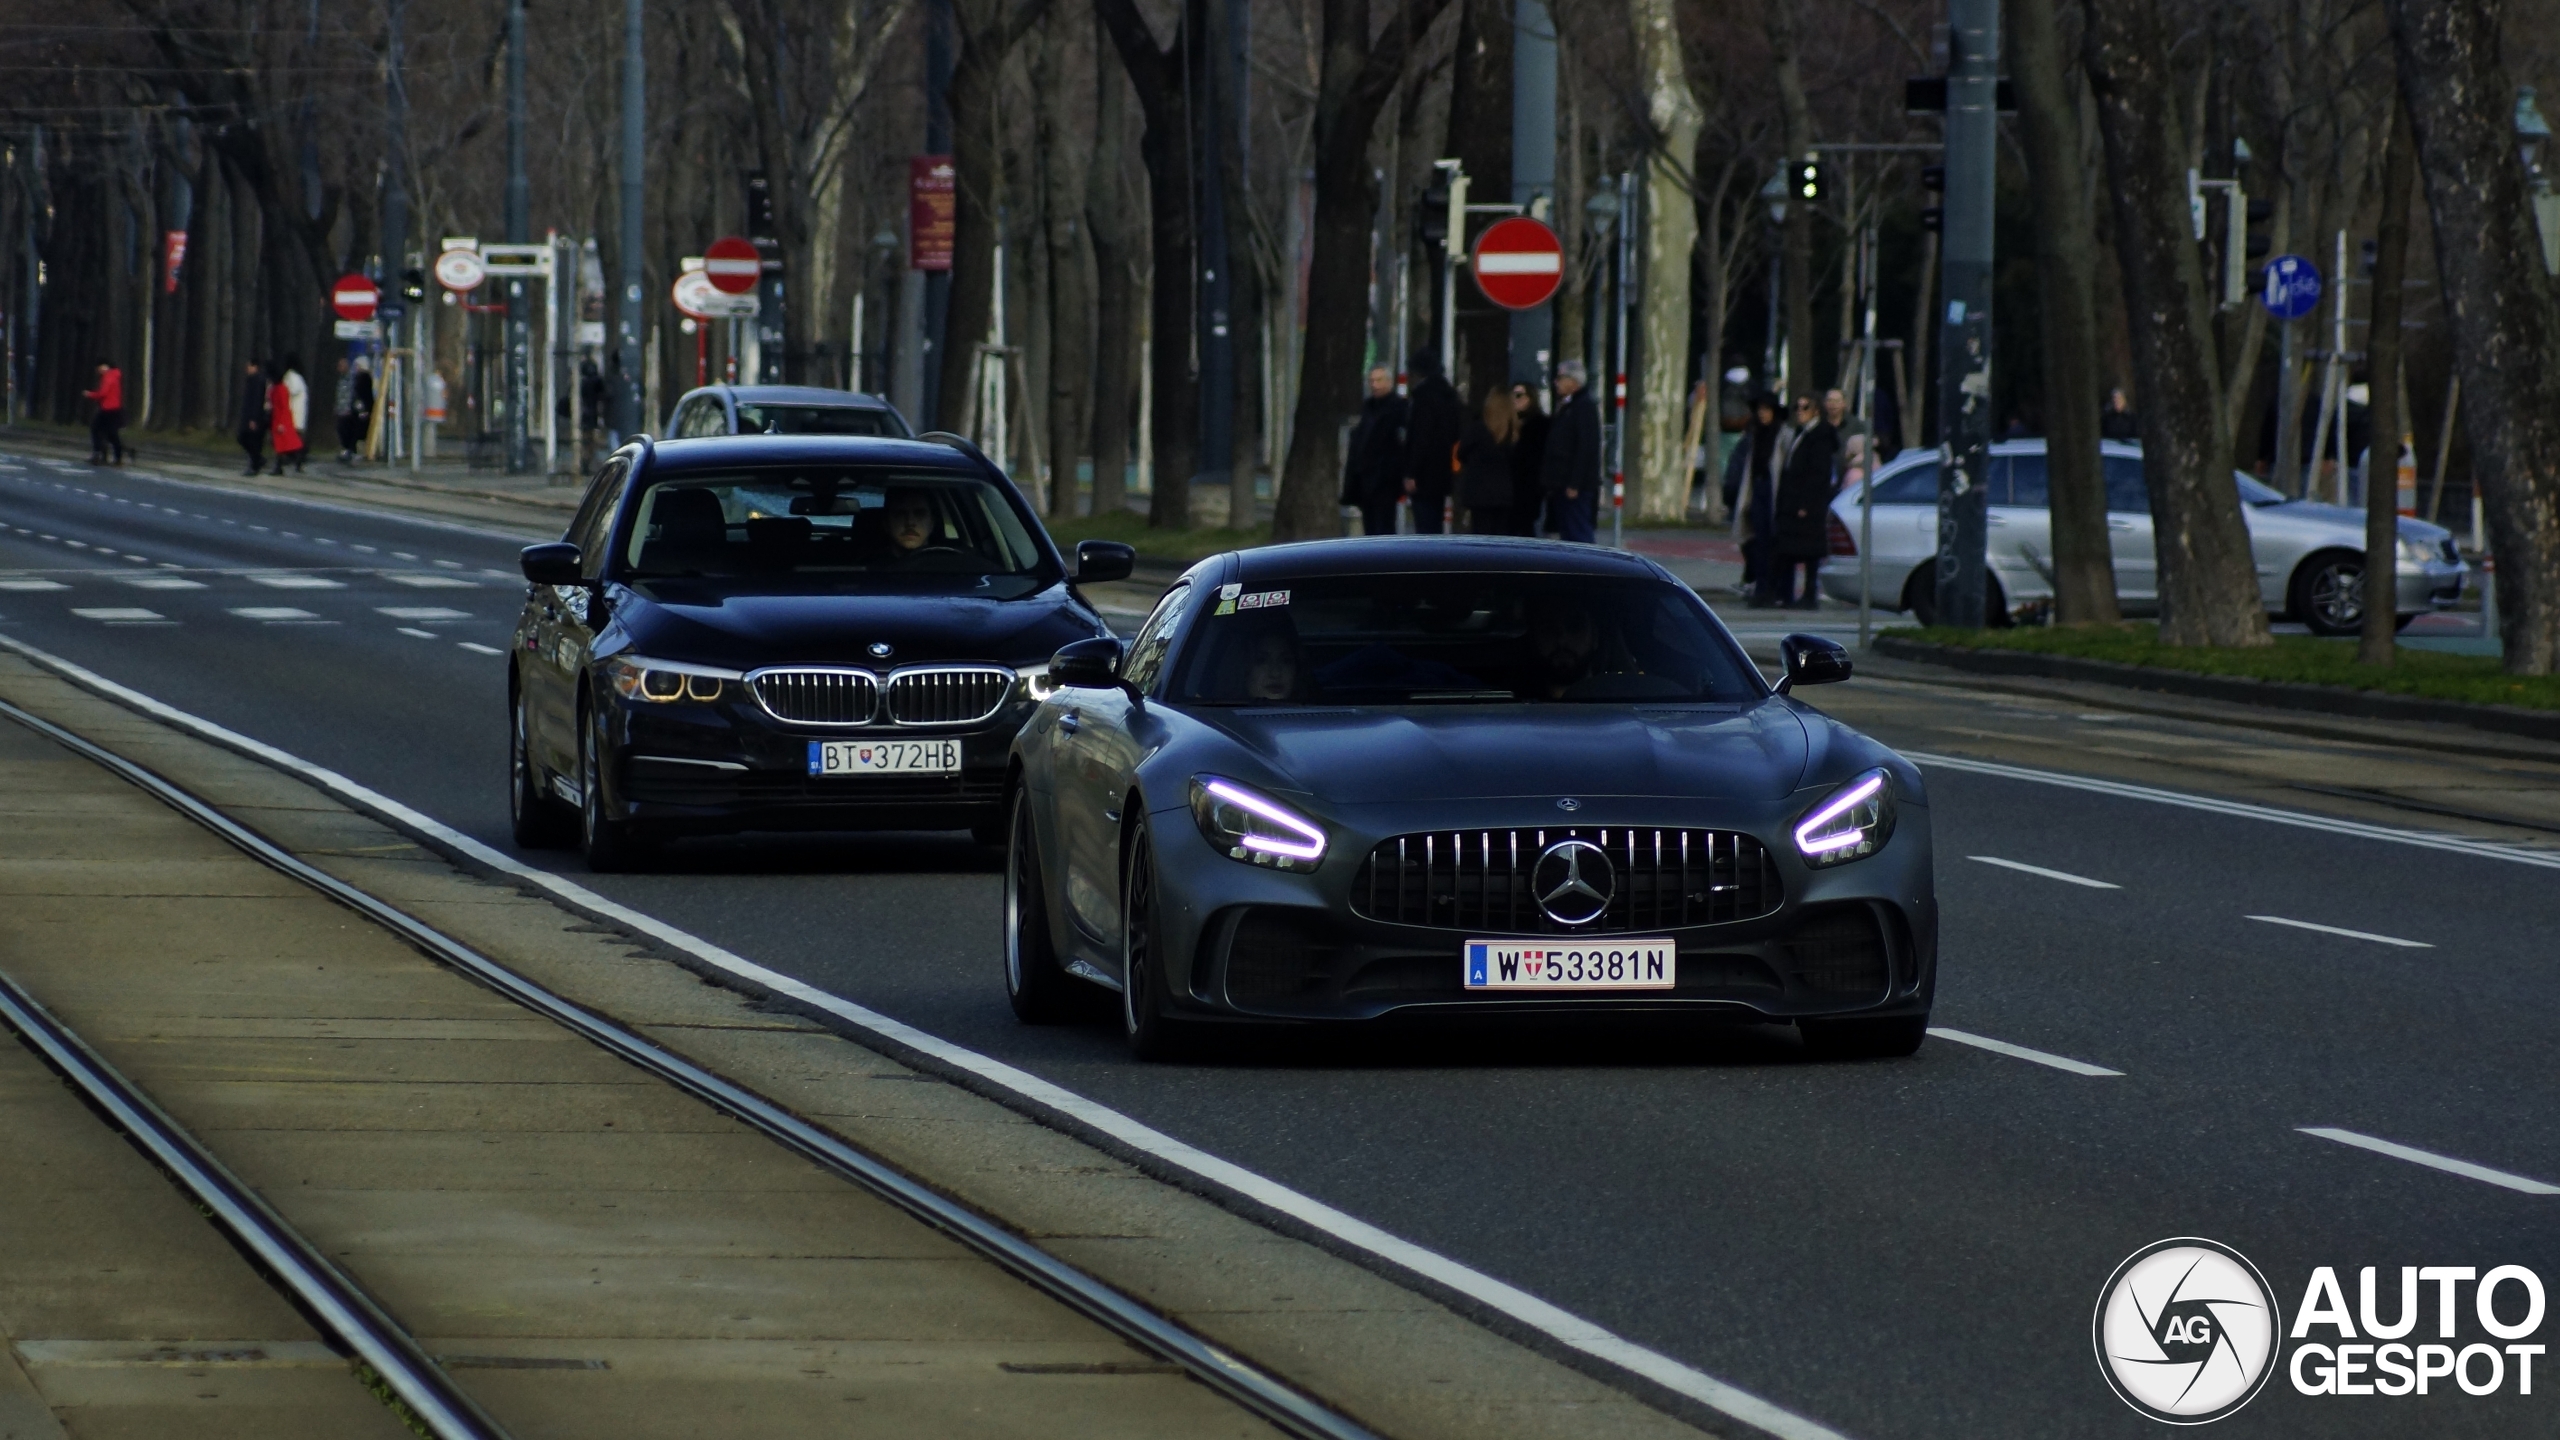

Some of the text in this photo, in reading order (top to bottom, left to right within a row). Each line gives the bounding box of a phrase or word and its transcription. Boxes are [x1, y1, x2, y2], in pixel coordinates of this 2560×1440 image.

[826, 743, 957, 770] BT 372HB
[1474, 970, 1483, 980] A
[1498, 950, 1664, 981] W 53381N
